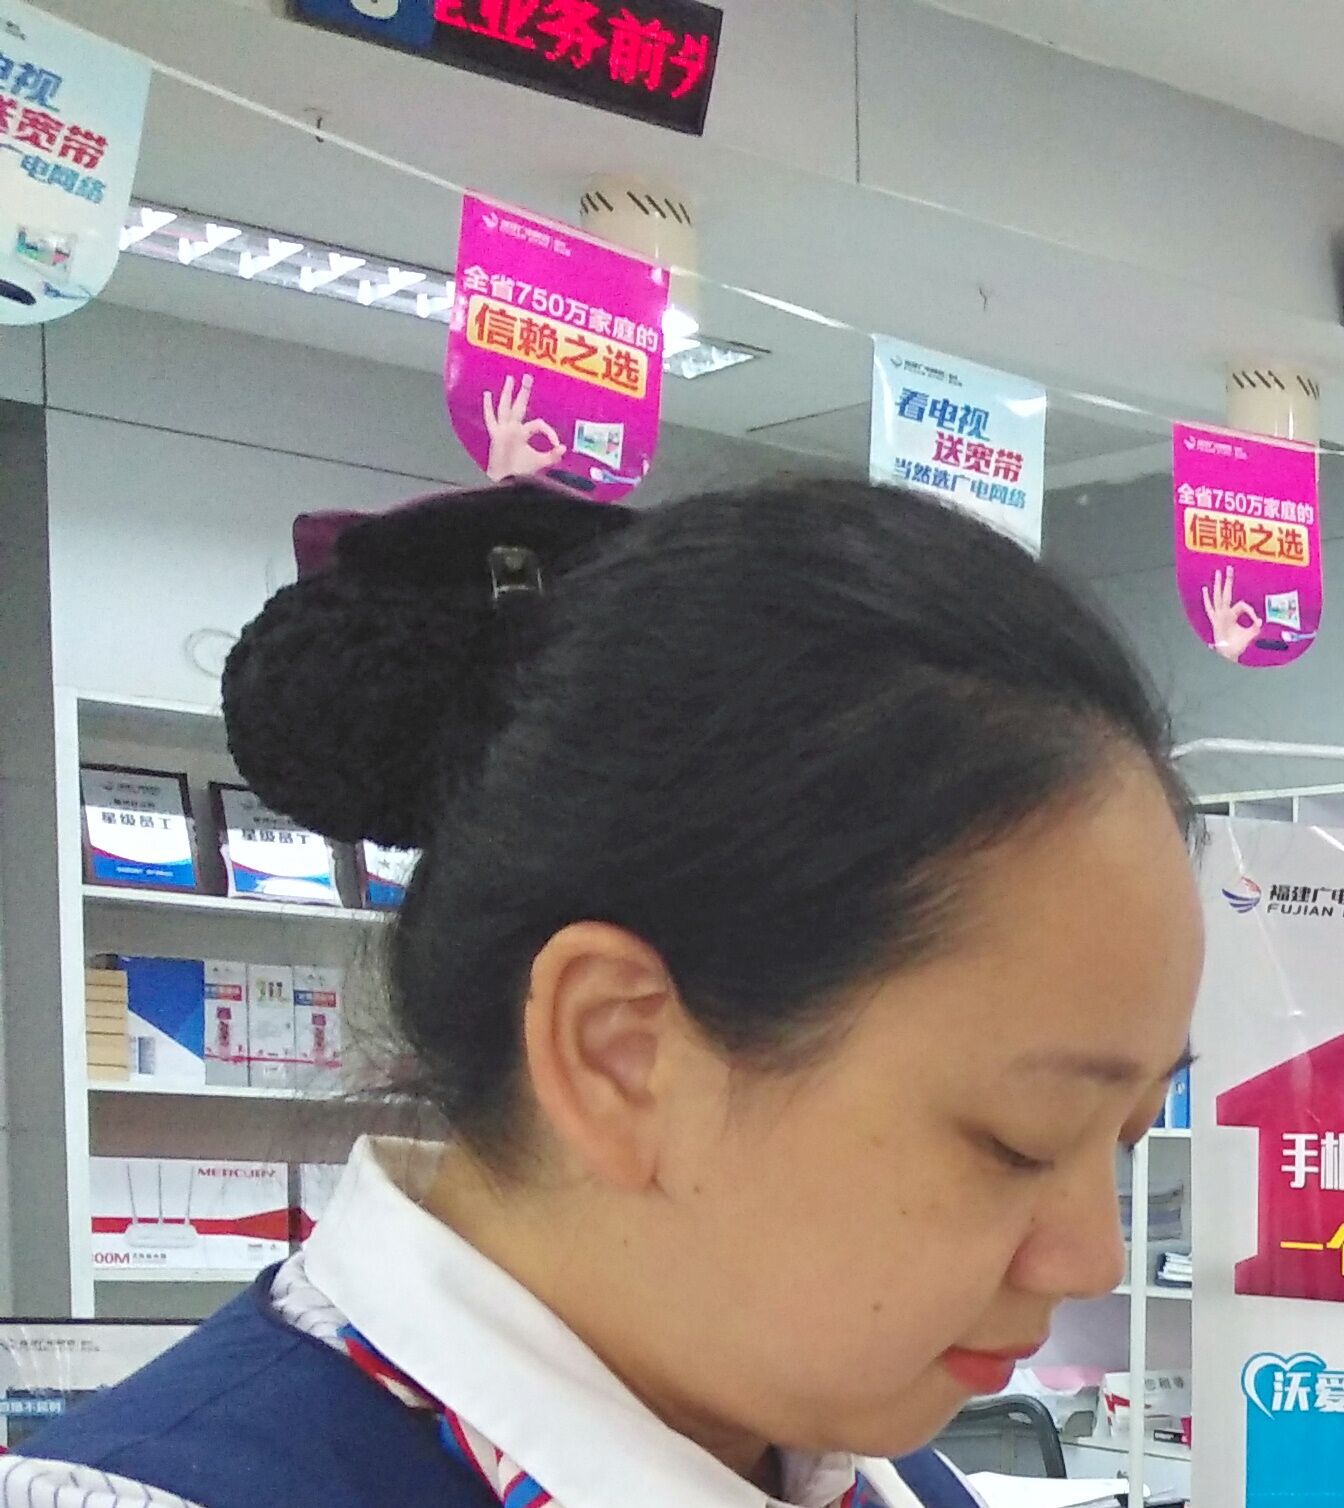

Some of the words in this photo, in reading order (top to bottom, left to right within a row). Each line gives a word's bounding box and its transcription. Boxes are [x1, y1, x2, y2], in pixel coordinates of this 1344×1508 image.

[0, 143, 106, 203] 电网络
[464, 265, 658, 353] 全省750万家庭的
[475, 303, 640, 392] 信赖之选
[895, 387, 990, 441] 看电视
[932, 431, 1024, 482] 送宽带
[895, 457, 1026, 509] 当然选广电网络
[1178, 483, 1314, 525] 全省750万家庭的
[1190, 514, 1304, 561] 信赖之选
[1267, 904, 1334, 918] FUJIAN
